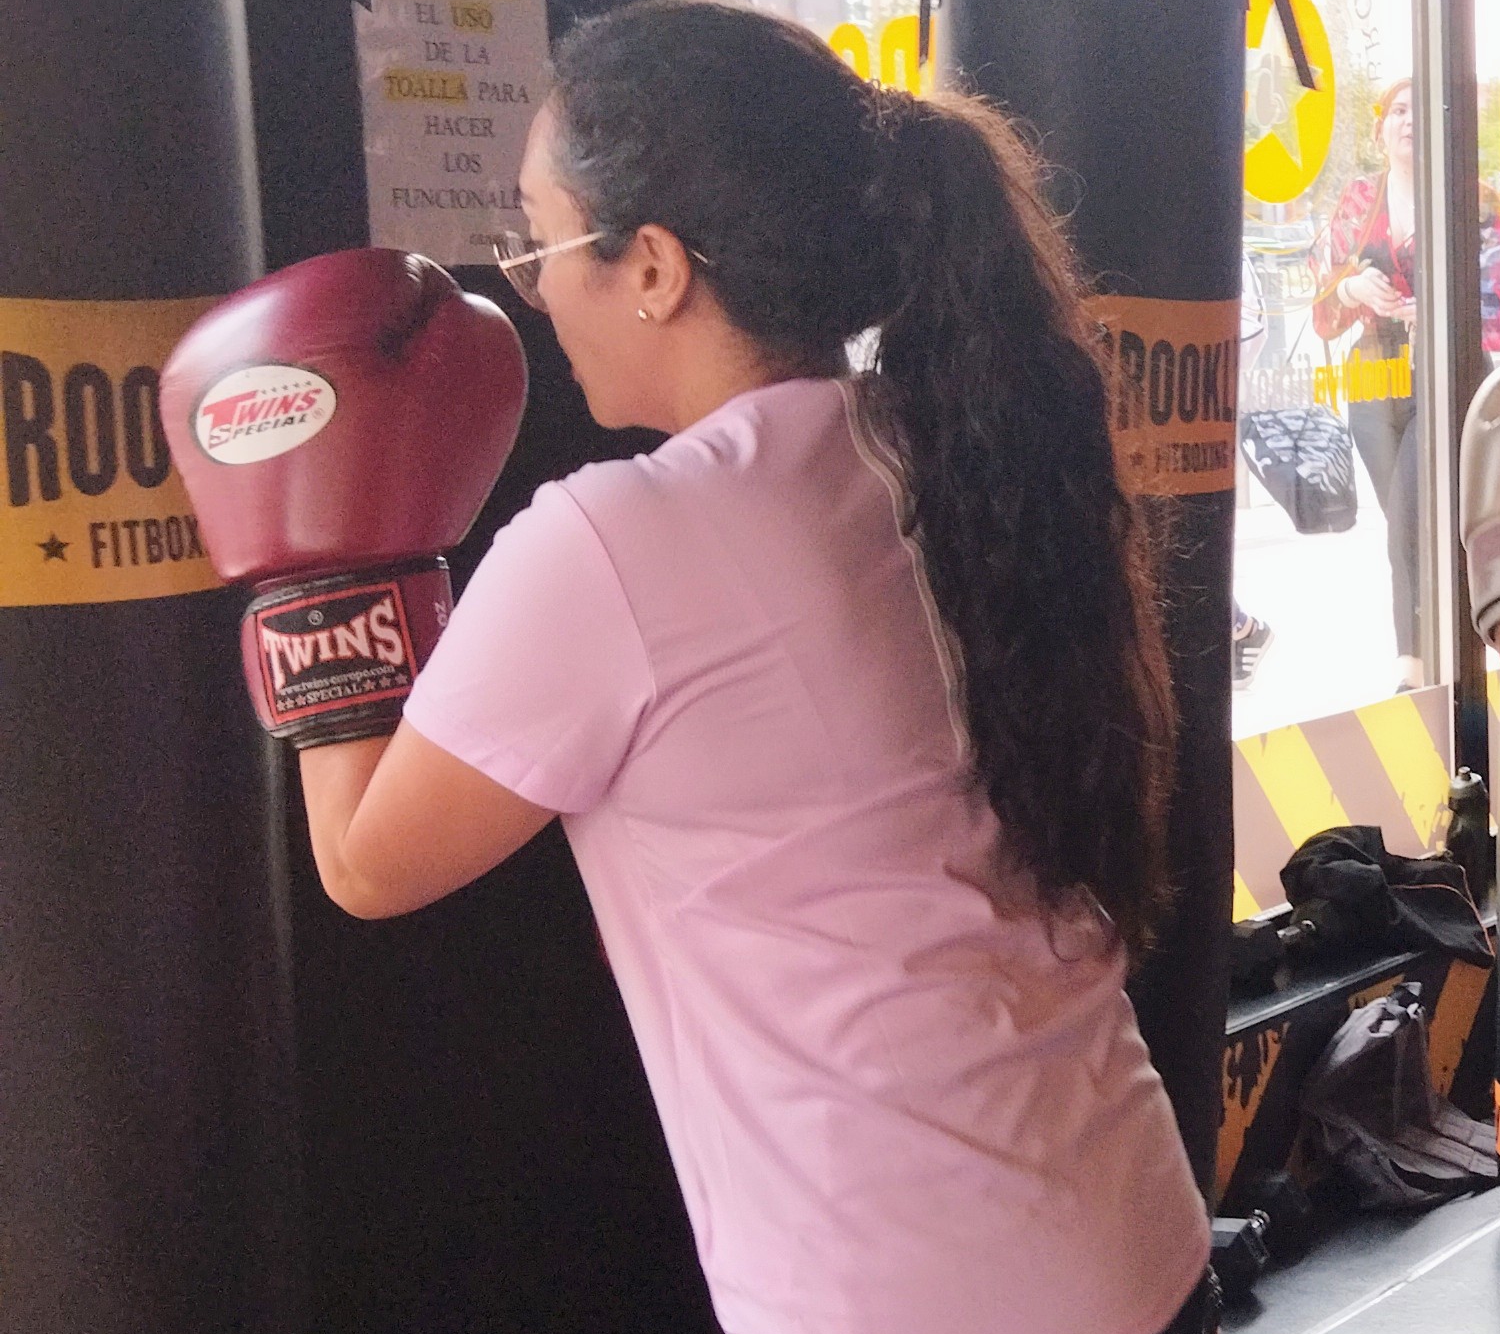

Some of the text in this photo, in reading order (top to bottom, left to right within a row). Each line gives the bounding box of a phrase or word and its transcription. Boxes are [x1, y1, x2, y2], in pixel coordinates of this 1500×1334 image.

[415, 3, 493, 29] EL USO
[425, 41, 489, 65] DE LA
[384, 75, 530, 104] TOALLA PARA
[423, 116, 495, 137] HACER
[444, 152, 481, 173] LOS
[262, 596, 404, 693] TWINS
[305, 686, 362, 704] SPECIAL
